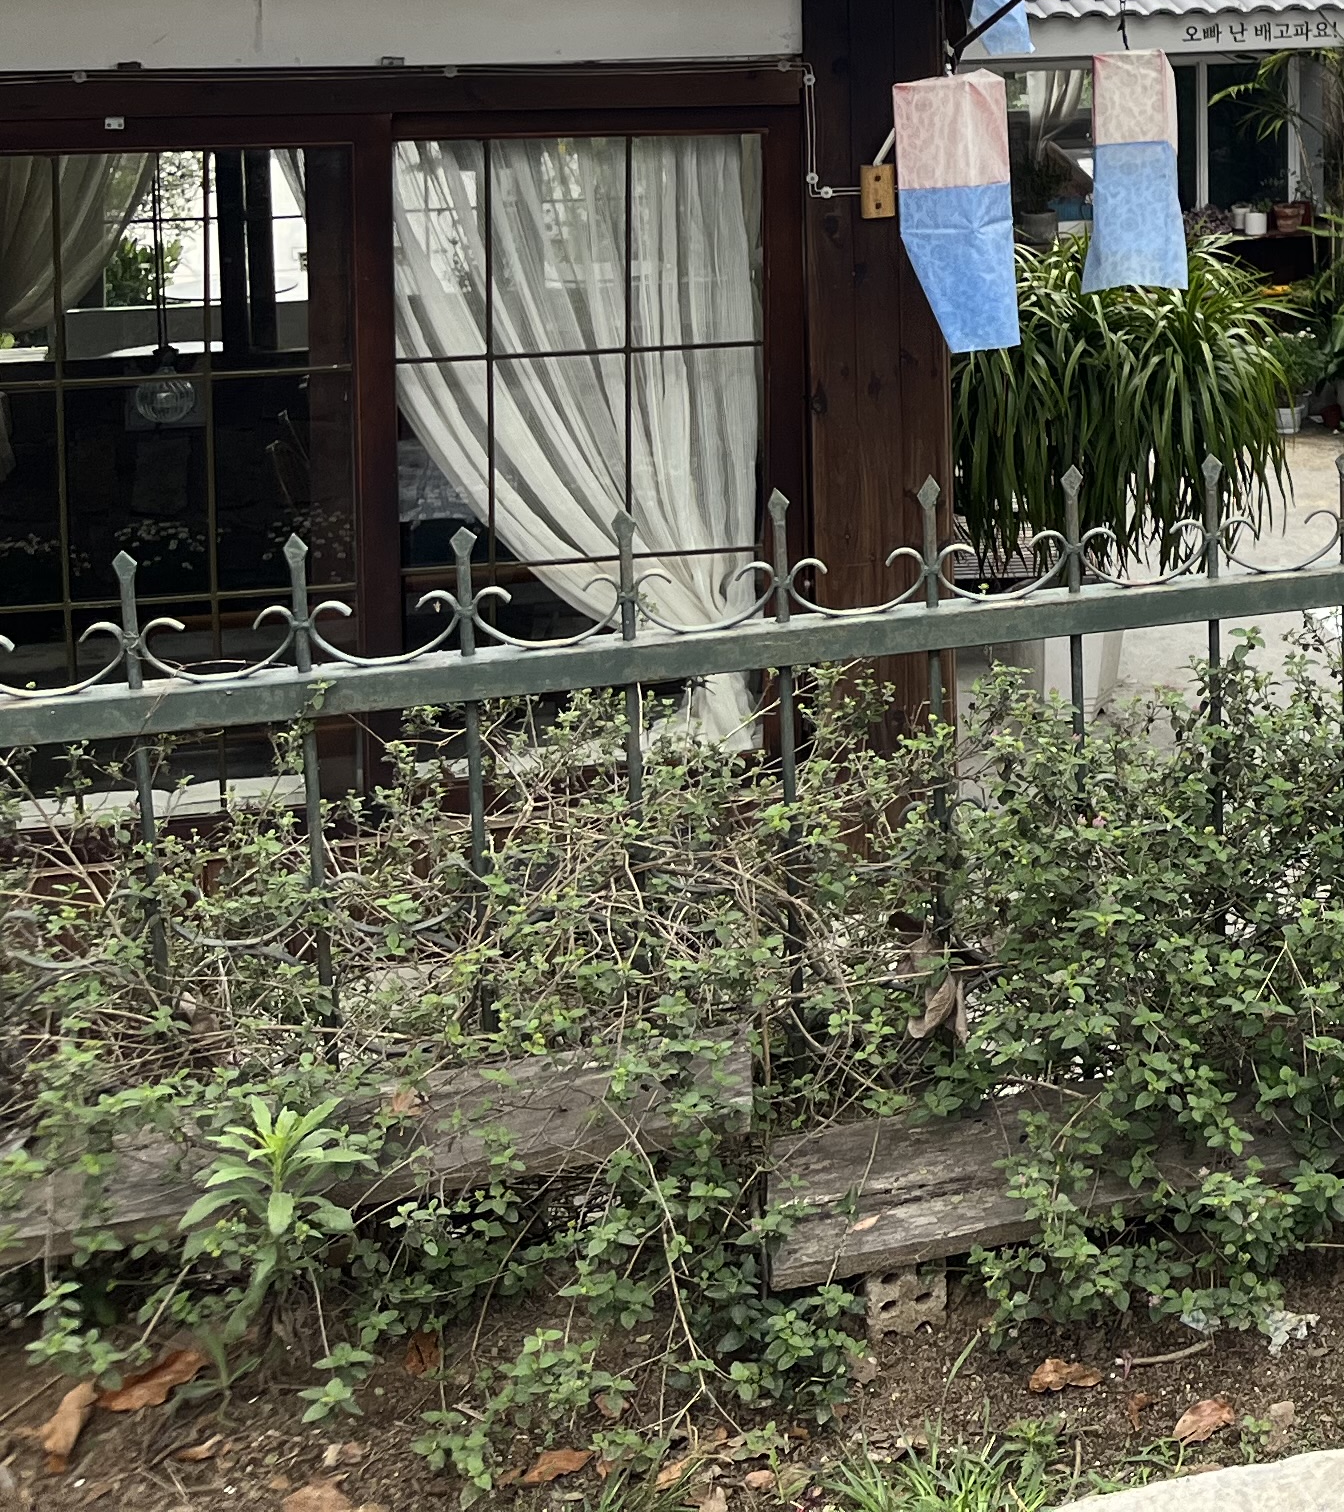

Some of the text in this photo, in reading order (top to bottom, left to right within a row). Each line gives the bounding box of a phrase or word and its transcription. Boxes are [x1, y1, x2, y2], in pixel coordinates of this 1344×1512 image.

[1182, 20, 1338, 43] 오빠 난 배고파요!
